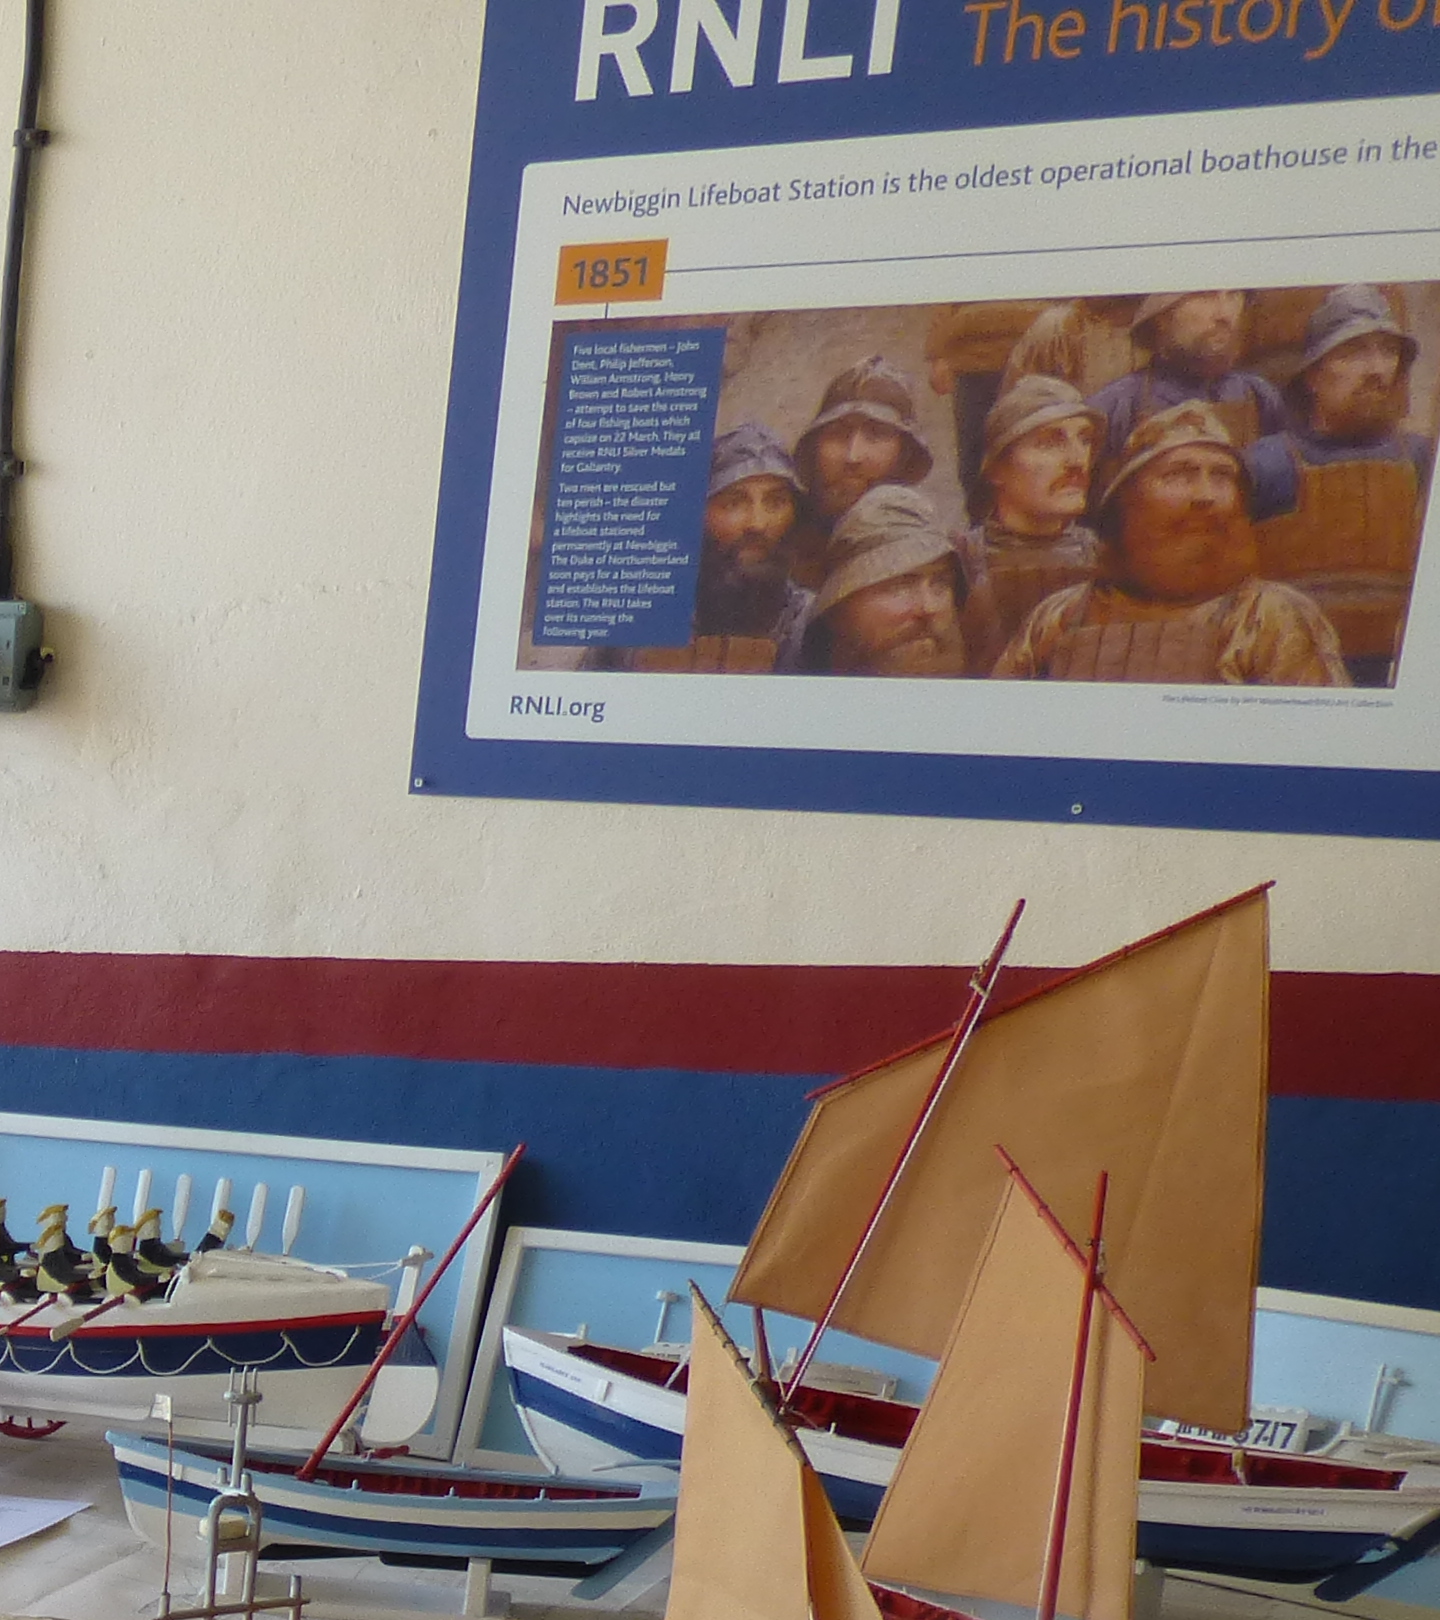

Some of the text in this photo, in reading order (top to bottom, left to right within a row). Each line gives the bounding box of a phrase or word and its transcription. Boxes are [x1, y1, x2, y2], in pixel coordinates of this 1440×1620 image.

[574, 0, 1440, 102] RNLI The history o
[562, 135, 1439, 218] Newbiggin Lifeboat Station is the oldest operational boathouse in the
[573, 257, 648, 290] 1851
[574, 345, 592, 355] Five
[594, 344, 617, 354] local
[620, 343, 667, 353] fishermen
[676, 341, 700, 353] John
[600, 359, 626, 370] Philip
[571, 375, 607, 384] William
[664, 372, 694, 383] Henry
[569, 387, 707, 400] Brown and Robert Armstrong
[575, 404, 612, 415] attempt
[616, 404, 626, 412] to
[652, 402, 667, 411] the
[566, 416, 690, 429] of four fishing boats which
[564, 435, 597, 445] capsize
[614, 433, 625, 442] 22
[628, 432, 660, 442] March.
[664, 431, 686, 441] They
[688, 430, 700, 440] all
[562, 446, 686, 458] receive RNLI Silver Medals
[561, 464, 574, 472] for
[560, 482, 676, 492] Two men are rescued but
[557, 498, 572, 507] ten
[574, 498, 603, 509] perish
[613, 497, 629, 506] the
[631, 497, 669, 506] disaster
[556, 510, 660, 523] highlights the need for
[562, 526, 597, 536] lifeboat
[600, 526, 645, 536] stationed
[552, 541, 612, 553] permanently
[552, 554, 689, 565] The Duke of Northumberland
[549, 571, 571, 579] soon
[573, 571, 595, 581] pays
[597, 570, 610, 579] for
[621, 569, 671, 579] boathouse
[548, 584, 674, 594] and establishes the lifeboat
[583, 598, 599, 607] The
[602, 599, 624, 607] RNLI
[627, 598, 652, 607] takes
[566, 614, 578, 622] its
[580, 615, 616, 624] running
[618, 614, 633, 622] the
[543, 627, 585, 638] following
[510, 695, 606, 723] RNLI.org
